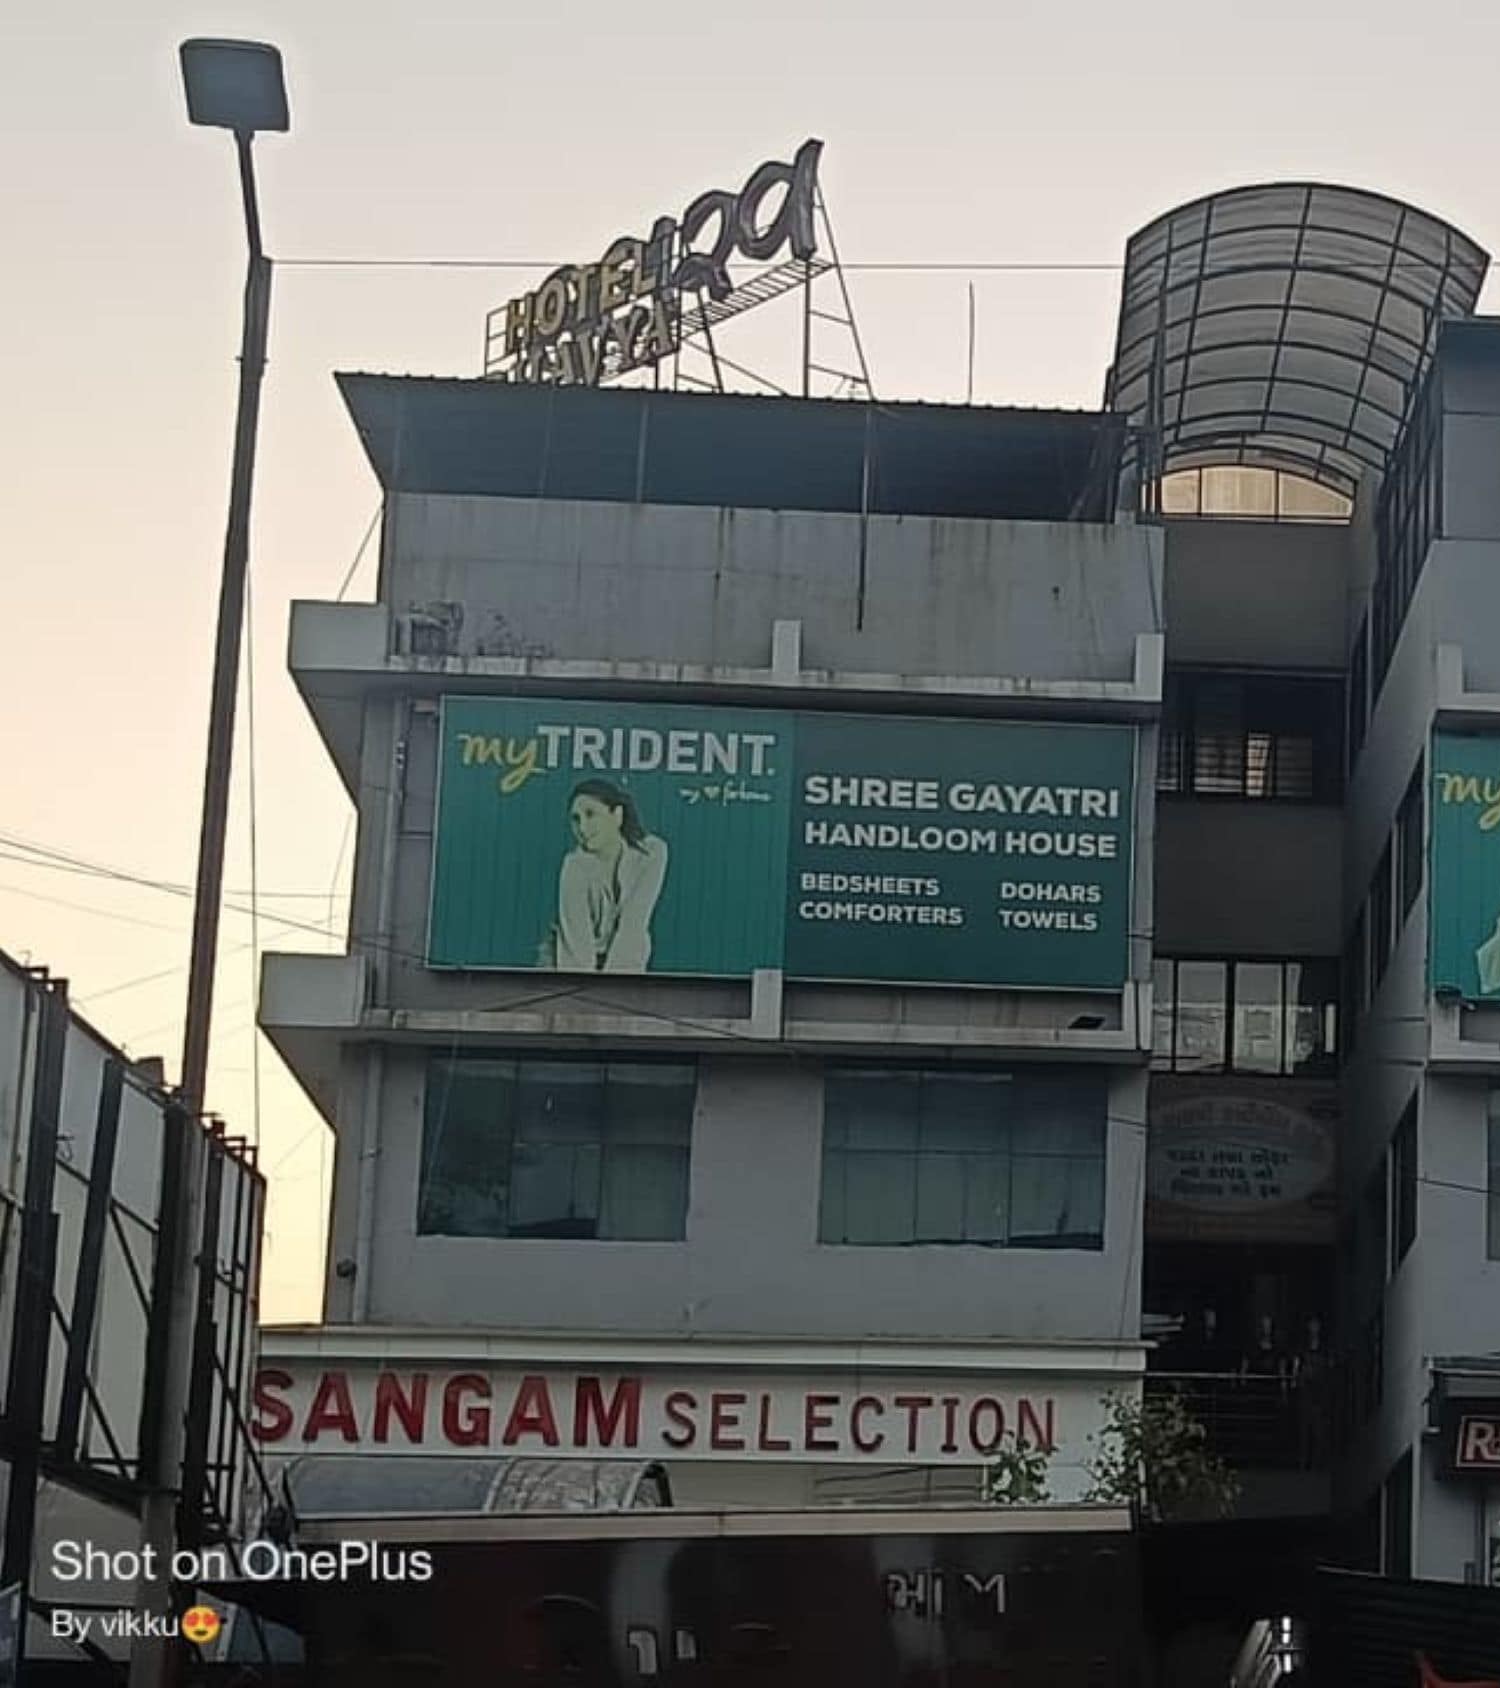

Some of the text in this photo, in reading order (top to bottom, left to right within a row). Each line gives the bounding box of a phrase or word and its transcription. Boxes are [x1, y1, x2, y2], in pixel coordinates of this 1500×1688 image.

[505, 240, 657, 354] HOTEL
[804, 775, 939, 810] SHREE
[949, 783, 1119, 818] GAYATRI
[804, 821, 1117, 858] HANDLOOM HOUSE
[801, 872, 940, 896] BEDSHEETS
[1001, 882, 1102, 903] DOHARS
[799, 901, 963, 925] COMFORTERS
[1000, 910, 1098, 931] TOWELS
[251, 1369, 1055, 1456] SANGAM SELECTION
